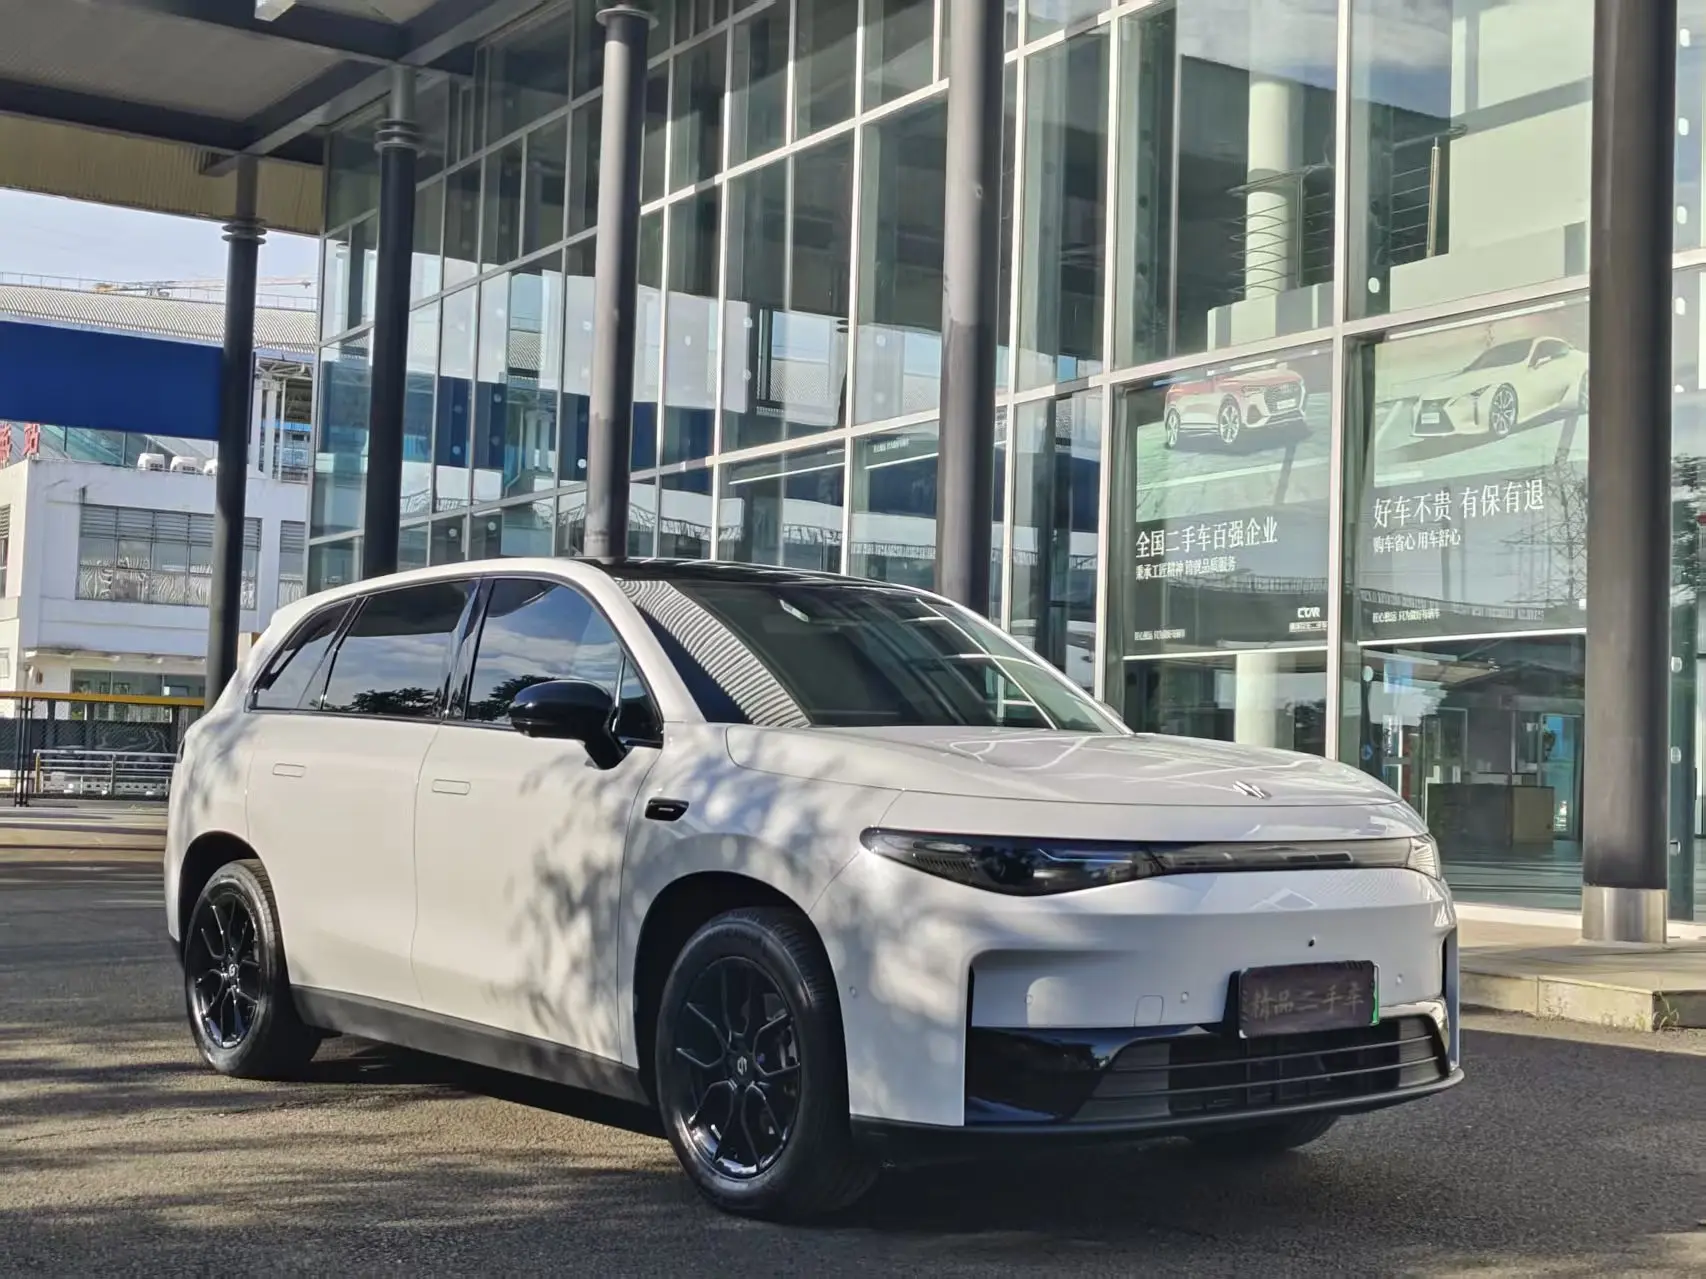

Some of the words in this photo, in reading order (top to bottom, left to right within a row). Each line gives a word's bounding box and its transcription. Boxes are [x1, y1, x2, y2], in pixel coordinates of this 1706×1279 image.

[1372, 489, 1451, 529] 好车不贵
[1459, 478, 1545, 519] 有保有退
[1135, 516, 1278, 558] 全国二手车百强企业
[1373, 533, 1416, 554] 购车省心
[1417, 527, 1461, 549] 用车舒心
